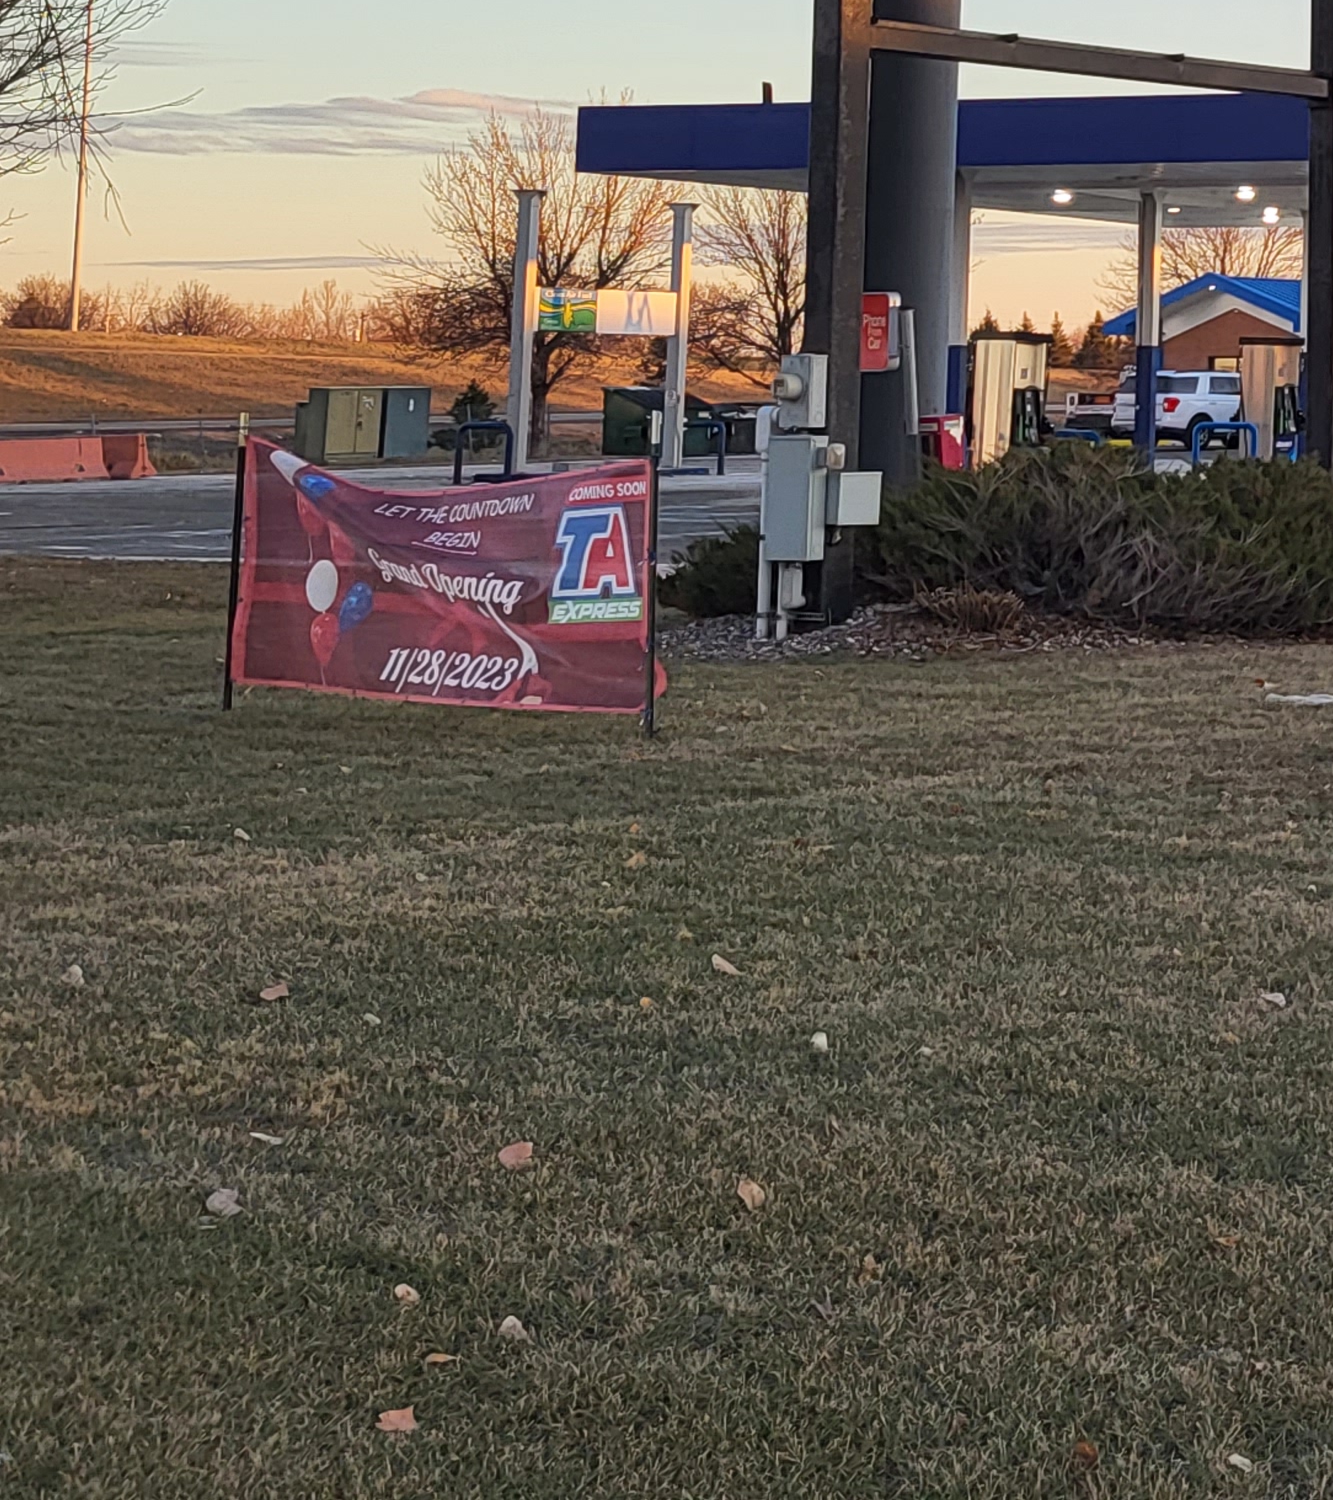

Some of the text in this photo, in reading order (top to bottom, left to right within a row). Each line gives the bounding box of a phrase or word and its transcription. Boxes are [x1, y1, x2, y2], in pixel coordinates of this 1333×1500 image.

[569, 480, 646, 501] COMING SOON
[374, 493, 535, 524] LET THE COUNTDOWN
[425, 531, 481, 549] BEGIN
[552, 504, 637, 600] TA
[367, 548, 525, 615] Grand Opening
[549, 601, 641, 622] EXPRESS
[380, 647, 519, 696] 11/28/2023
